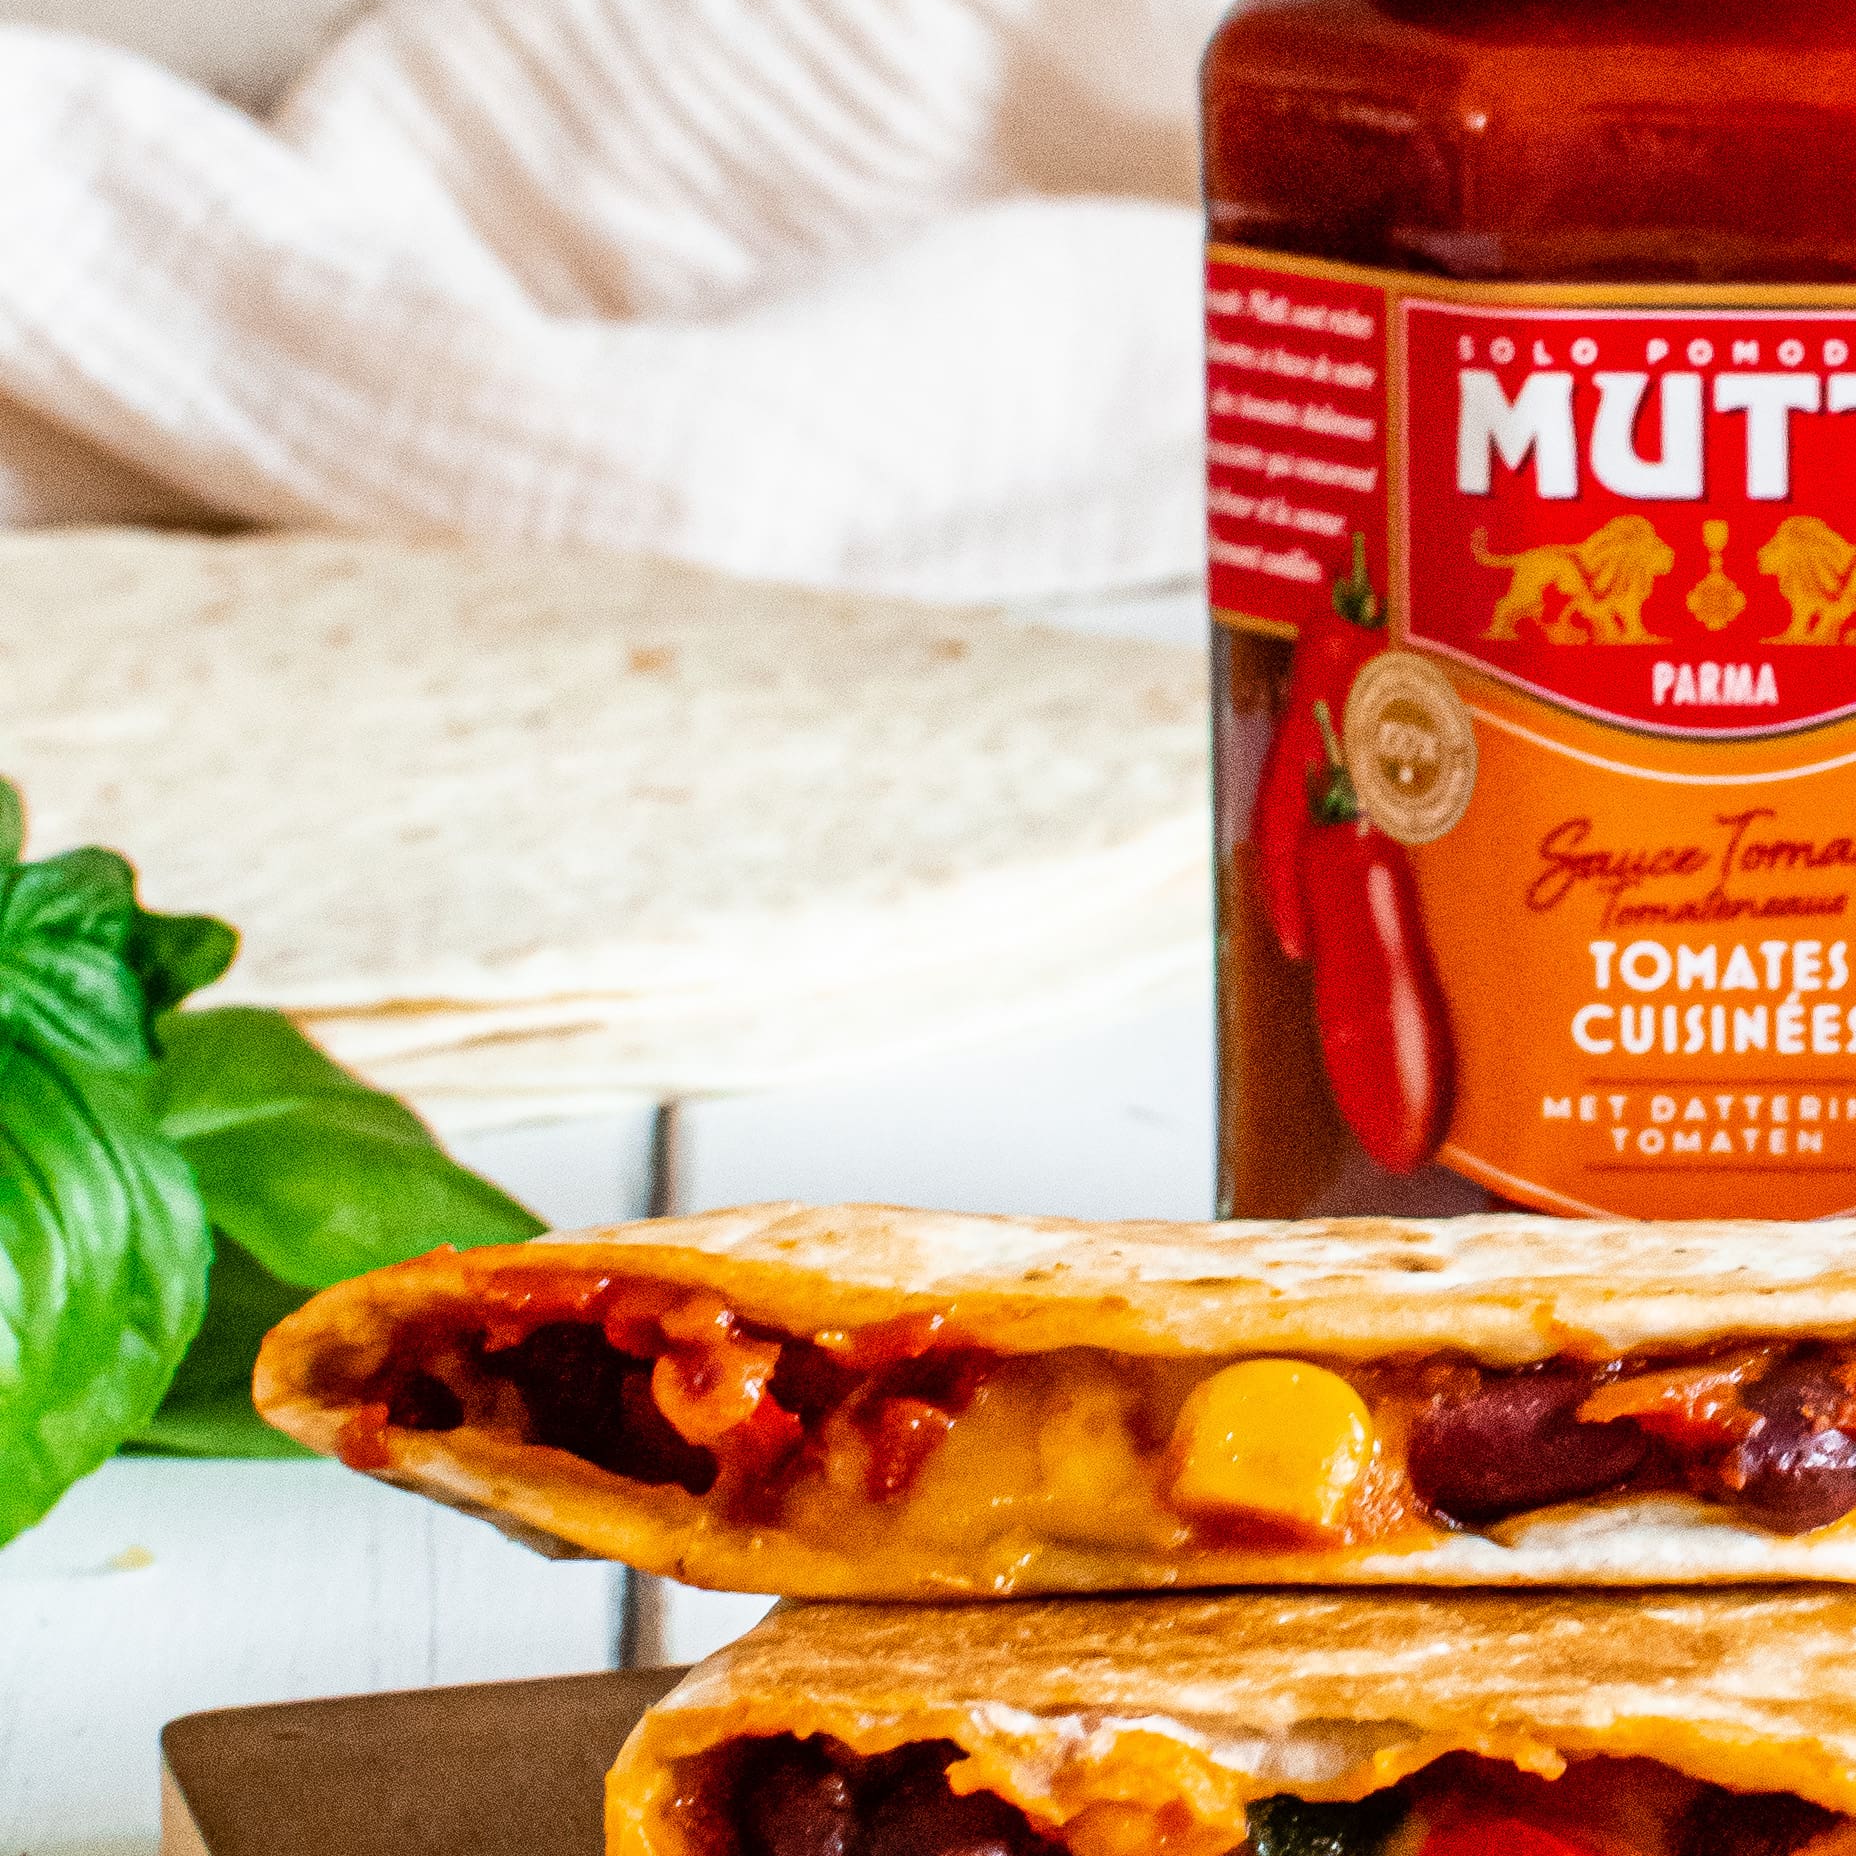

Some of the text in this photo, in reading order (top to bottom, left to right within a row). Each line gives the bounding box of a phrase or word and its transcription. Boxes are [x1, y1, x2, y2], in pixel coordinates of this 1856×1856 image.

[1459, 333, 1599, 367] SOLO
[1651, 660, 1779, 706] PARMA
[1525, 816, 1709, 913] Sauce
[1588, 940, 1849, 992] TOMATES
[1541, 1094, 1628, 1122] MET
[1610, 1128, 1824, 1156] TOMATEN
